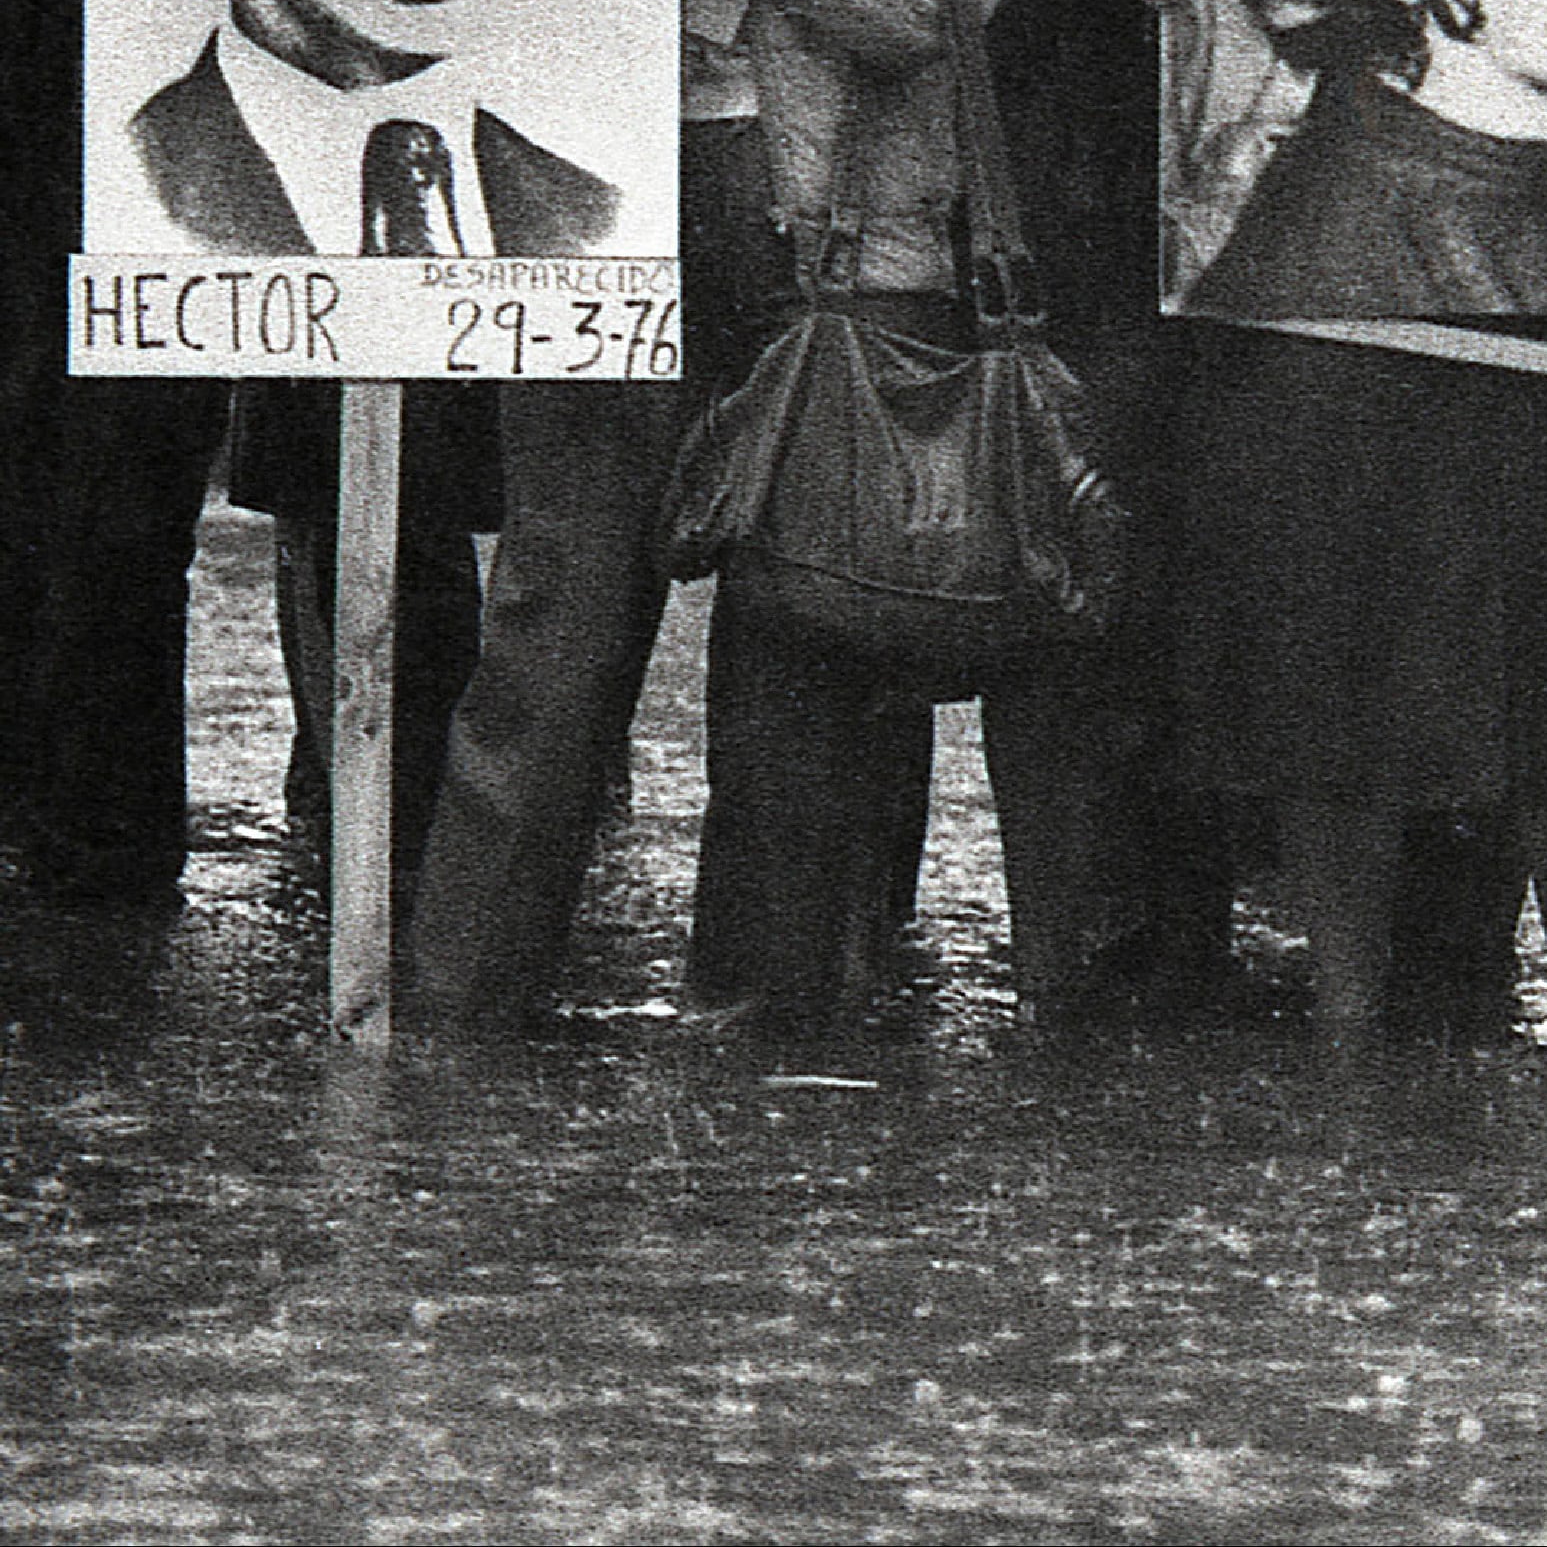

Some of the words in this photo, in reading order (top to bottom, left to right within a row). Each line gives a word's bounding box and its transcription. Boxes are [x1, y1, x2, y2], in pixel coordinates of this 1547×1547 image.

[84, 272, 341, 363] HECTOR
[419, 262, 677, 295] DESAPARECIDO
[446, 298, 680, 381] 29-3-76
